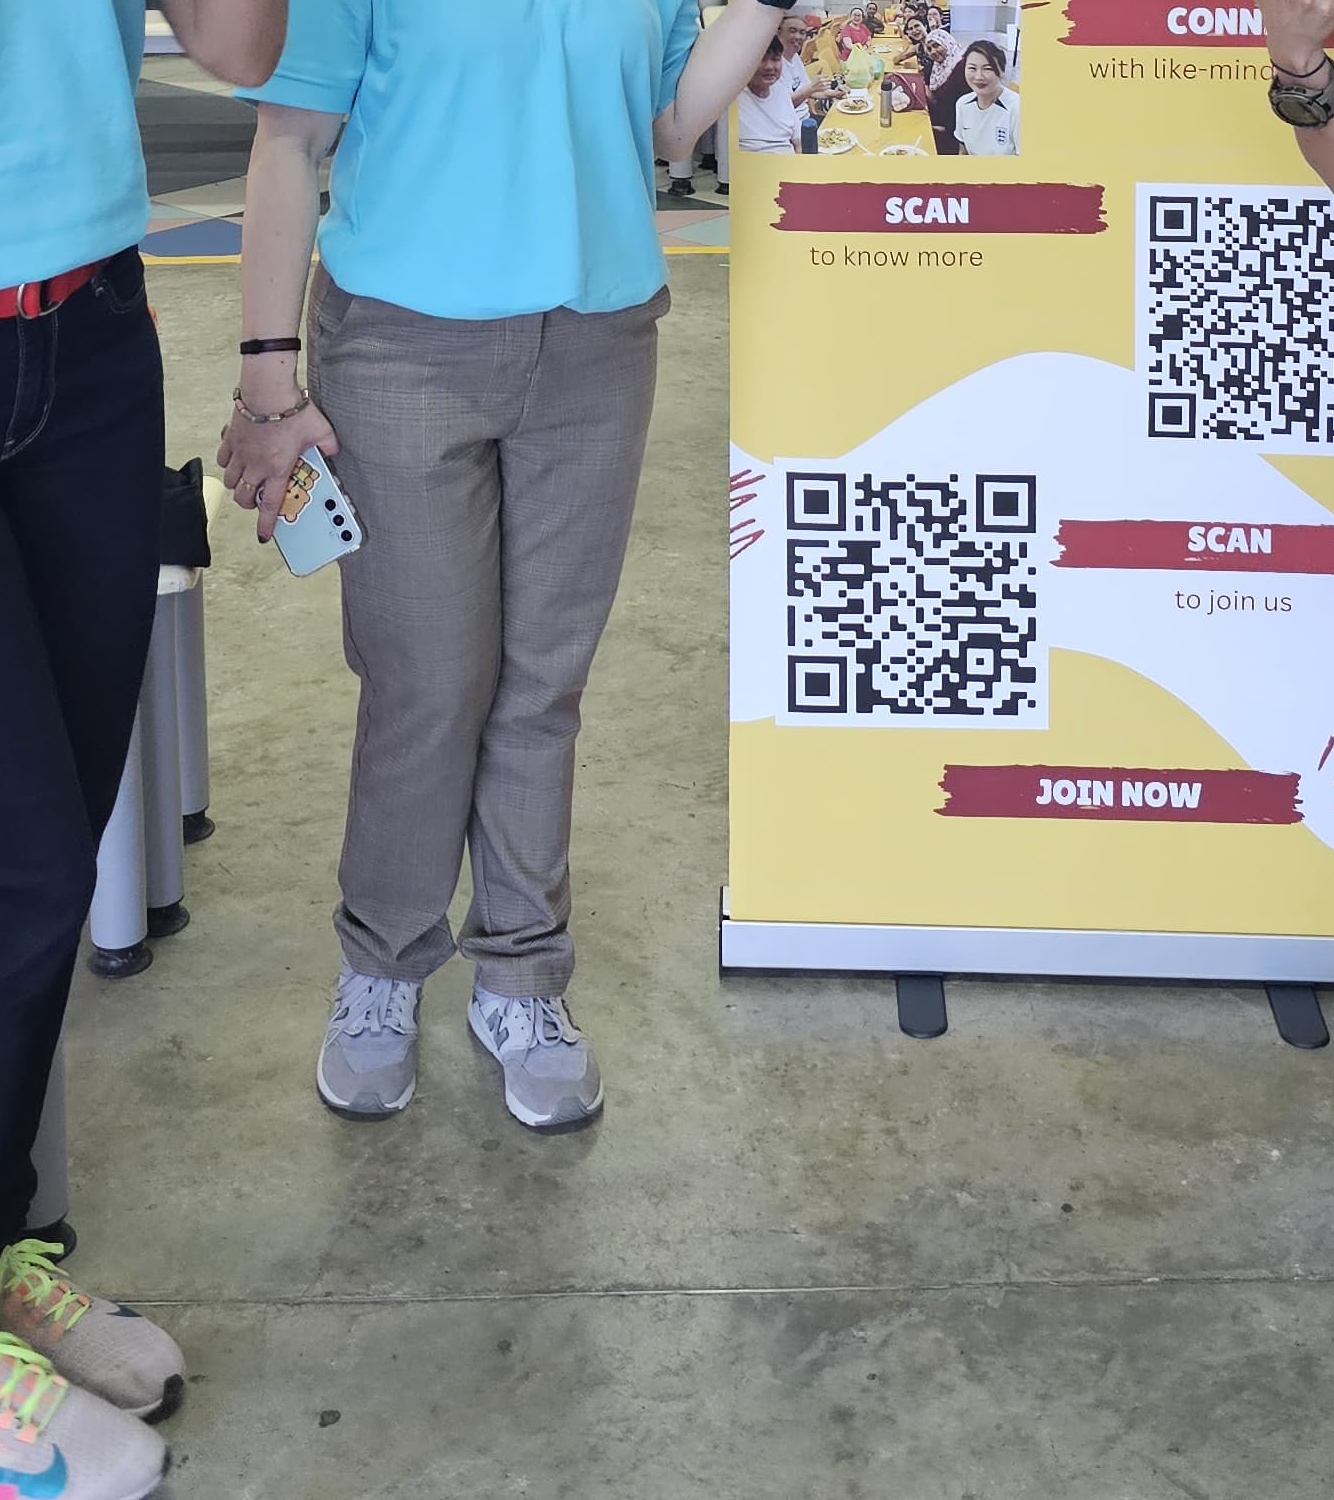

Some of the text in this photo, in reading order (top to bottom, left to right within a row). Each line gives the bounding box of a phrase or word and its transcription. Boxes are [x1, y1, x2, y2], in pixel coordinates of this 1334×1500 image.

[1167, 7, 1268, 35] CONN
[1089, 57, 1145, 79] with
[885, 197, 969, 225] SCAN
[810, 245, 984, 267] to know more
[1187, 526, 1273, 555] SCAN
[1175, 589, 1293, 616] to join us
[1035, 778, 1202, 809] JOIN NOW
